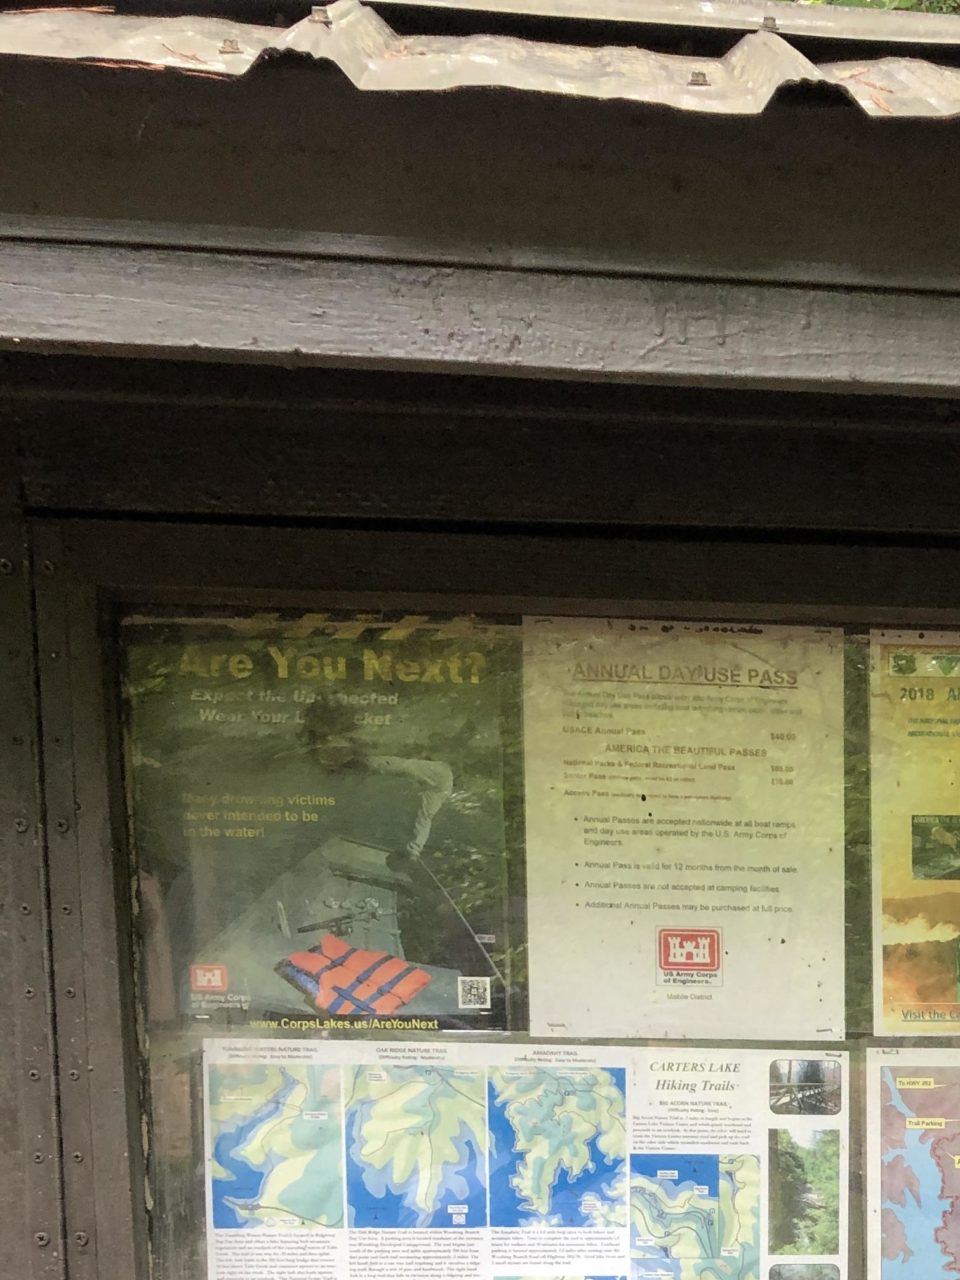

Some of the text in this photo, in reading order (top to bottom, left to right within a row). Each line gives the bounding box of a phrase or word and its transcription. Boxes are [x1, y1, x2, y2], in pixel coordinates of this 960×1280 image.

[180, 650, 486, 683] Are You Next?
[573, 663, 798, 685] ANNUAL DAY USE PASS
[900, 688, 935, 700] 2018
[252, 710, 289, 723] Your
[595, 727, 624, 735] Annual
[605, 744, 767, 757] AMERICA THE BEAUTIFUL PASSES
[288, 794, 335, 805] victims
[285, 811, 319, 822] to be
[200, 827, 264, 838] the water!
[613, 862, 631, 870] Pass
[662, 863, 672, 871] for
[685, 864, 713, 872] months
[715, 864, 731, 872] from
[747, 865, 770, 873] month
[585, 902, 772, 913] Additional Annual Passes may be purchased at full
[902, 1009, 925, 1020] Visit
[929, 1009, 946, 1020] the
[251, 1018, 438, 1030] www.CorpsLakes.us/AreYouNext
[650, 1062, 740, 1072] CARTERS LAKE
[656, 1079, 735, 1092] Hiking Trails
[921, 1120, 943, 1128] Parking
